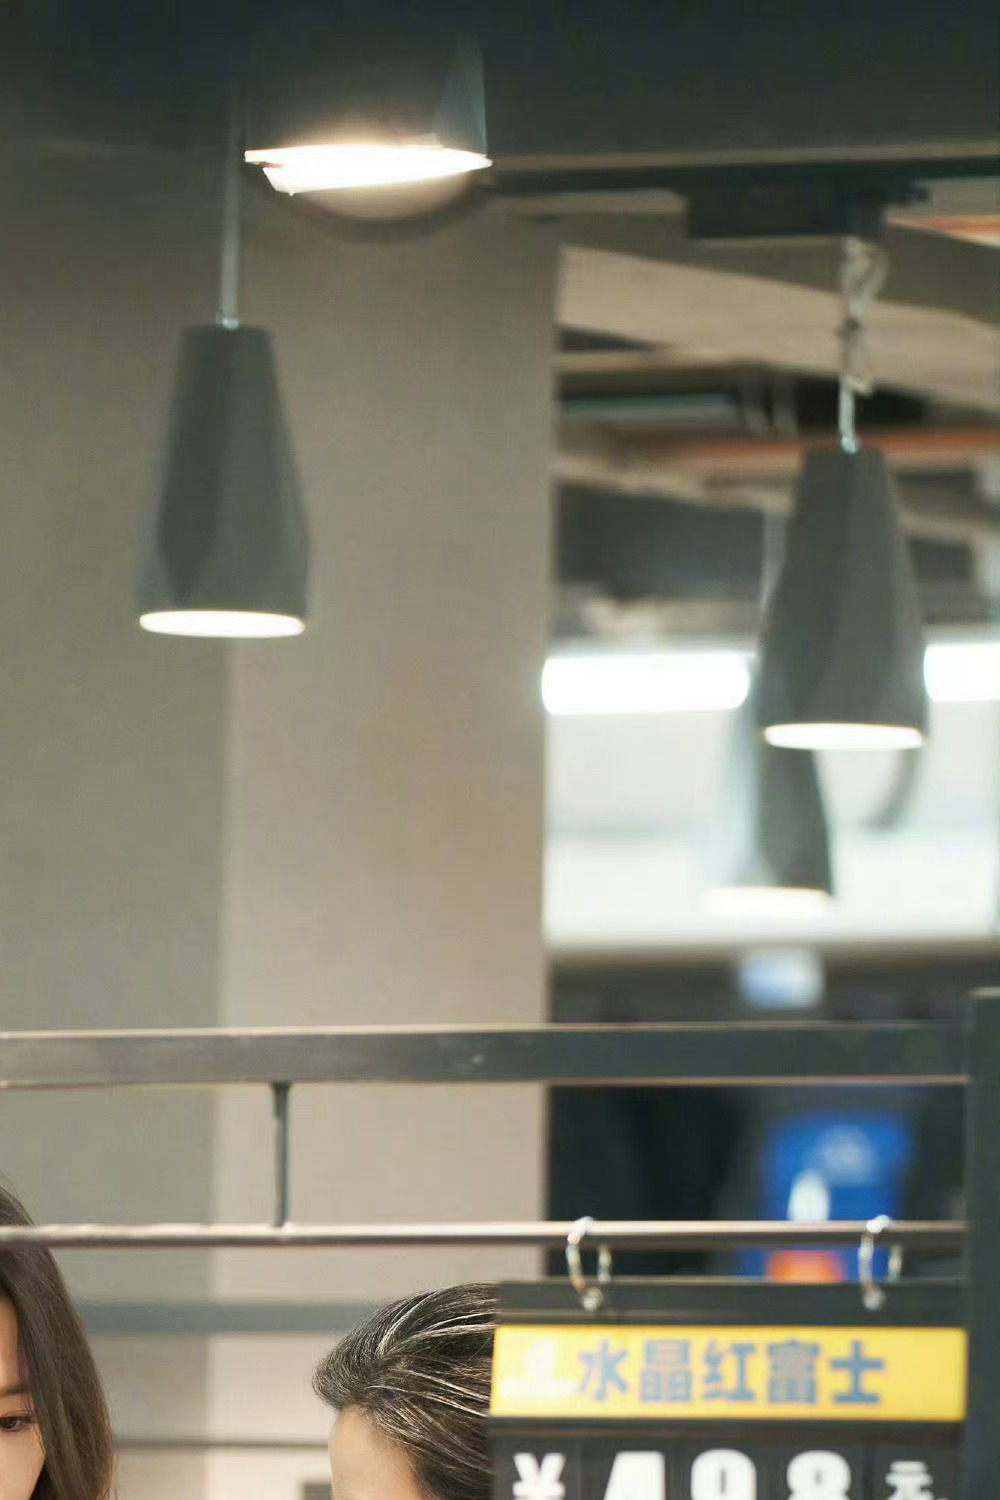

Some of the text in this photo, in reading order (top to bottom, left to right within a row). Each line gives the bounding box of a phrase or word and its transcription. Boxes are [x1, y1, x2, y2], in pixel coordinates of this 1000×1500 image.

[577, 1338, 886, 1405] 水晶红富士
